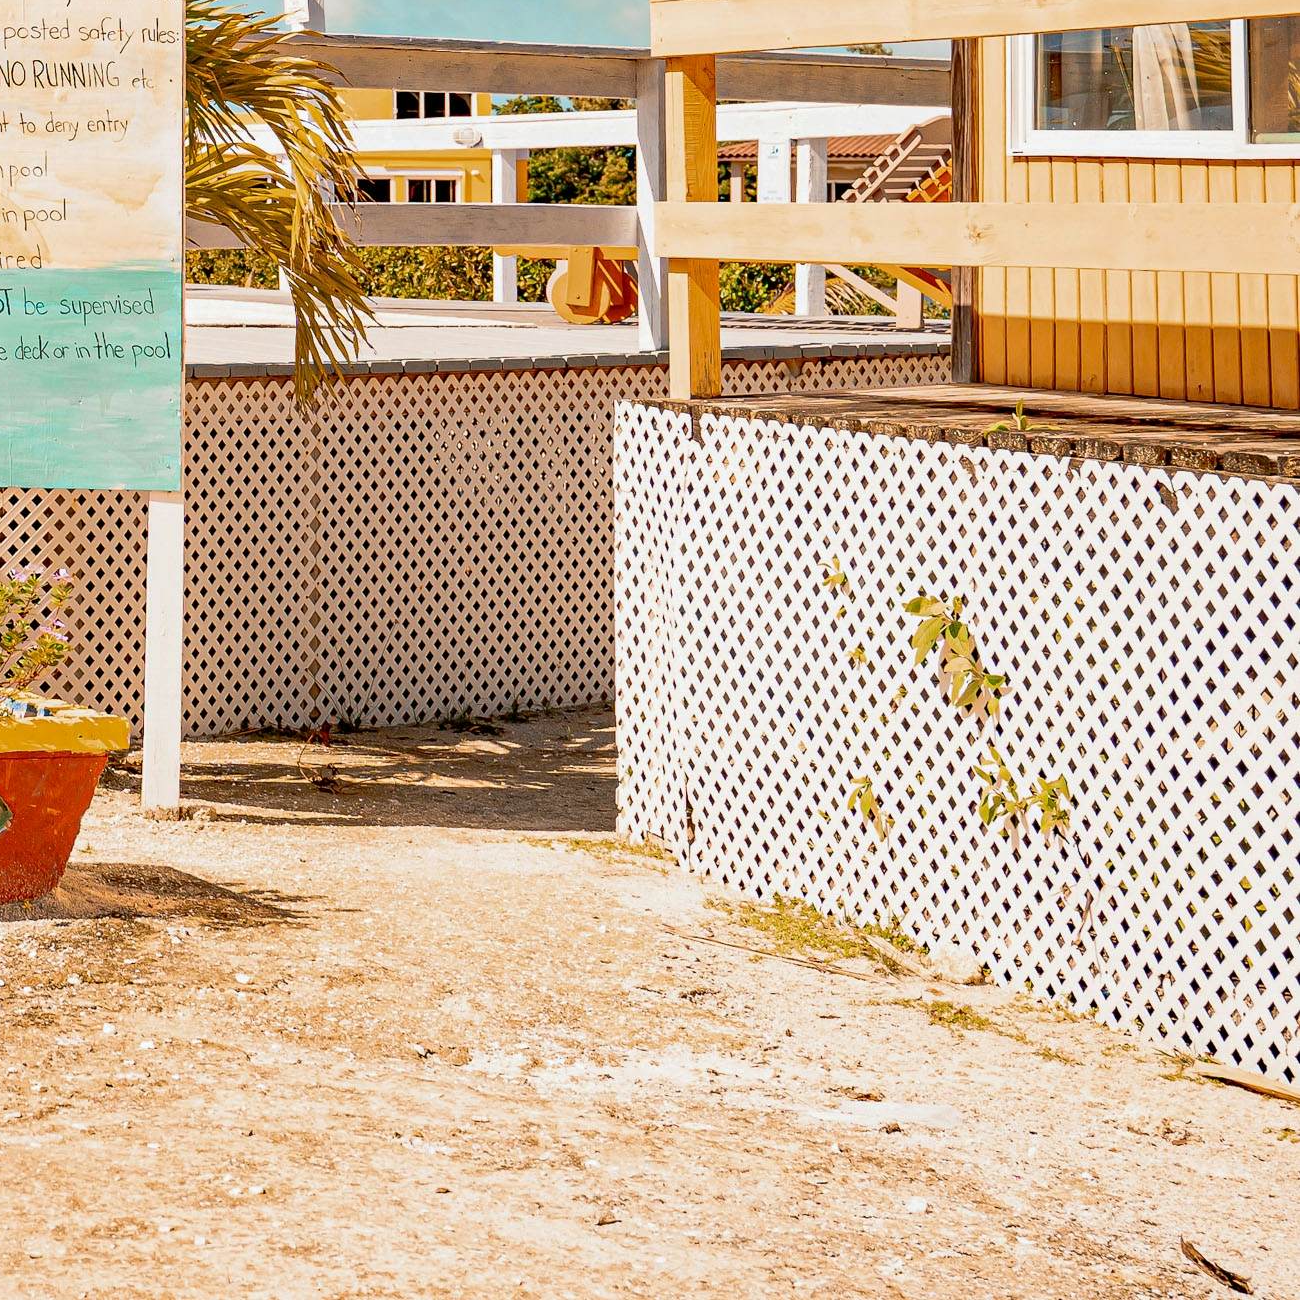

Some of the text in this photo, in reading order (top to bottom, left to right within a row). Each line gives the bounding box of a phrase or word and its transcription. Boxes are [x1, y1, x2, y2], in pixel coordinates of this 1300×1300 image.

[3, 18, 71, 49] posted
[79, 17, 135, 54] safety
[141, 18, 180, 44] rules:
[33, 60, 120, 89] RUNNING
[19, 111, 37, 134] to
[45, 109, 79, 141] deny
[87, 109, 128, 142] entry
[8, 150, 48, 187] pool
[1, 203, 18, 223] in
[23, 198, 67, 231] pool
[23, 290, 48, 316] be
[59, 288, 155, 326] supervised
[14, 333, 50, 360] deck
[53, 345, 71, 360] or
[75, 343, 91, 360] in
[93, 332, 125, 360] the
[133, 332, 172, 367] pool
